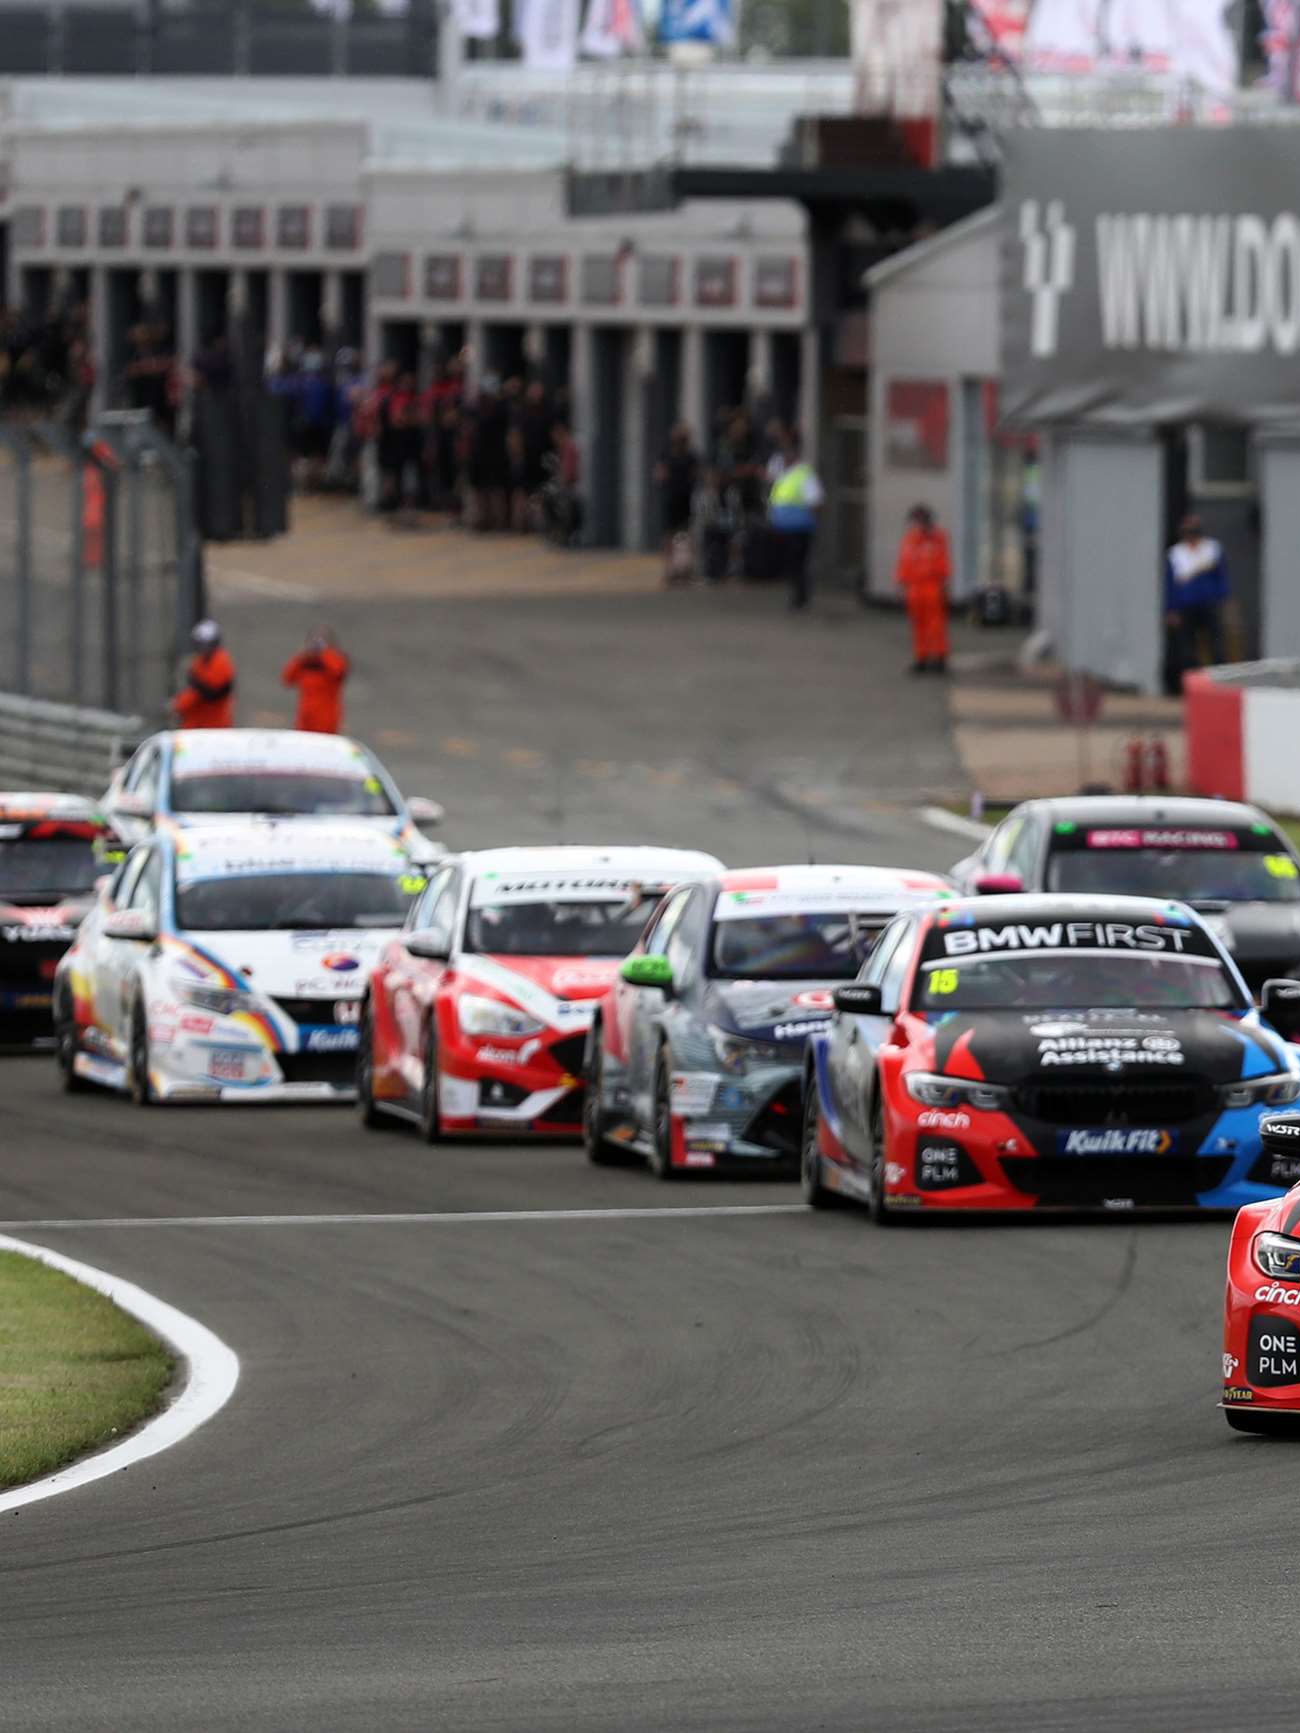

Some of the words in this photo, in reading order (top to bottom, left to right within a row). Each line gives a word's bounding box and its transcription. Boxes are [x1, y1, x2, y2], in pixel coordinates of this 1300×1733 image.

[929, 969, 958, 994] 15
[1038, 1037, 1139, 1052] Allianz
[1040, 1049, 1185, 1067] Assistance
[917, 1107, 971, 1129] cinch
[921, 1147, 958, 1164] ONE
[921, 1164, 960, 1180] PLM
[1259, 1334, 1297, 1353] ONE
[1259, 1356, 1297, 1375] PLM
